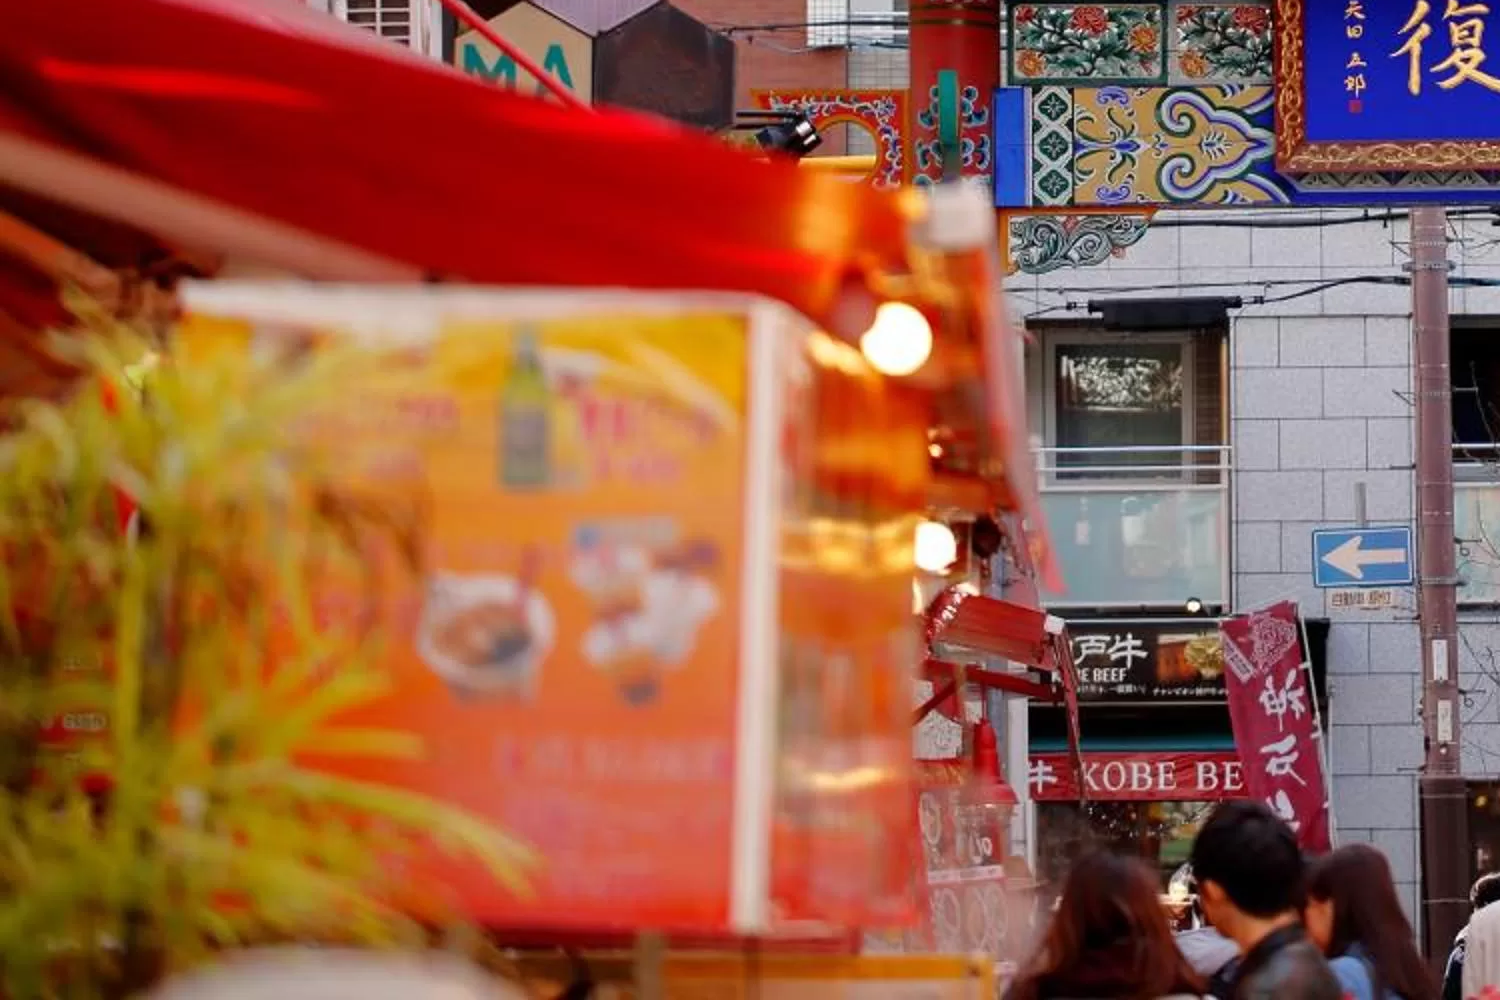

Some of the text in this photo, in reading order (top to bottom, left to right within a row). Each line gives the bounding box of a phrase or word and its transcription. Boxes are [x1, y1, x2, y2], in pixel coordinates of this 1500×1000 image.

[1069, 632, 1148, 669] 戸牛
[1094, 667, 1128, 682] BEEF
[1081, 760, 1244, 792] KOBE BE
